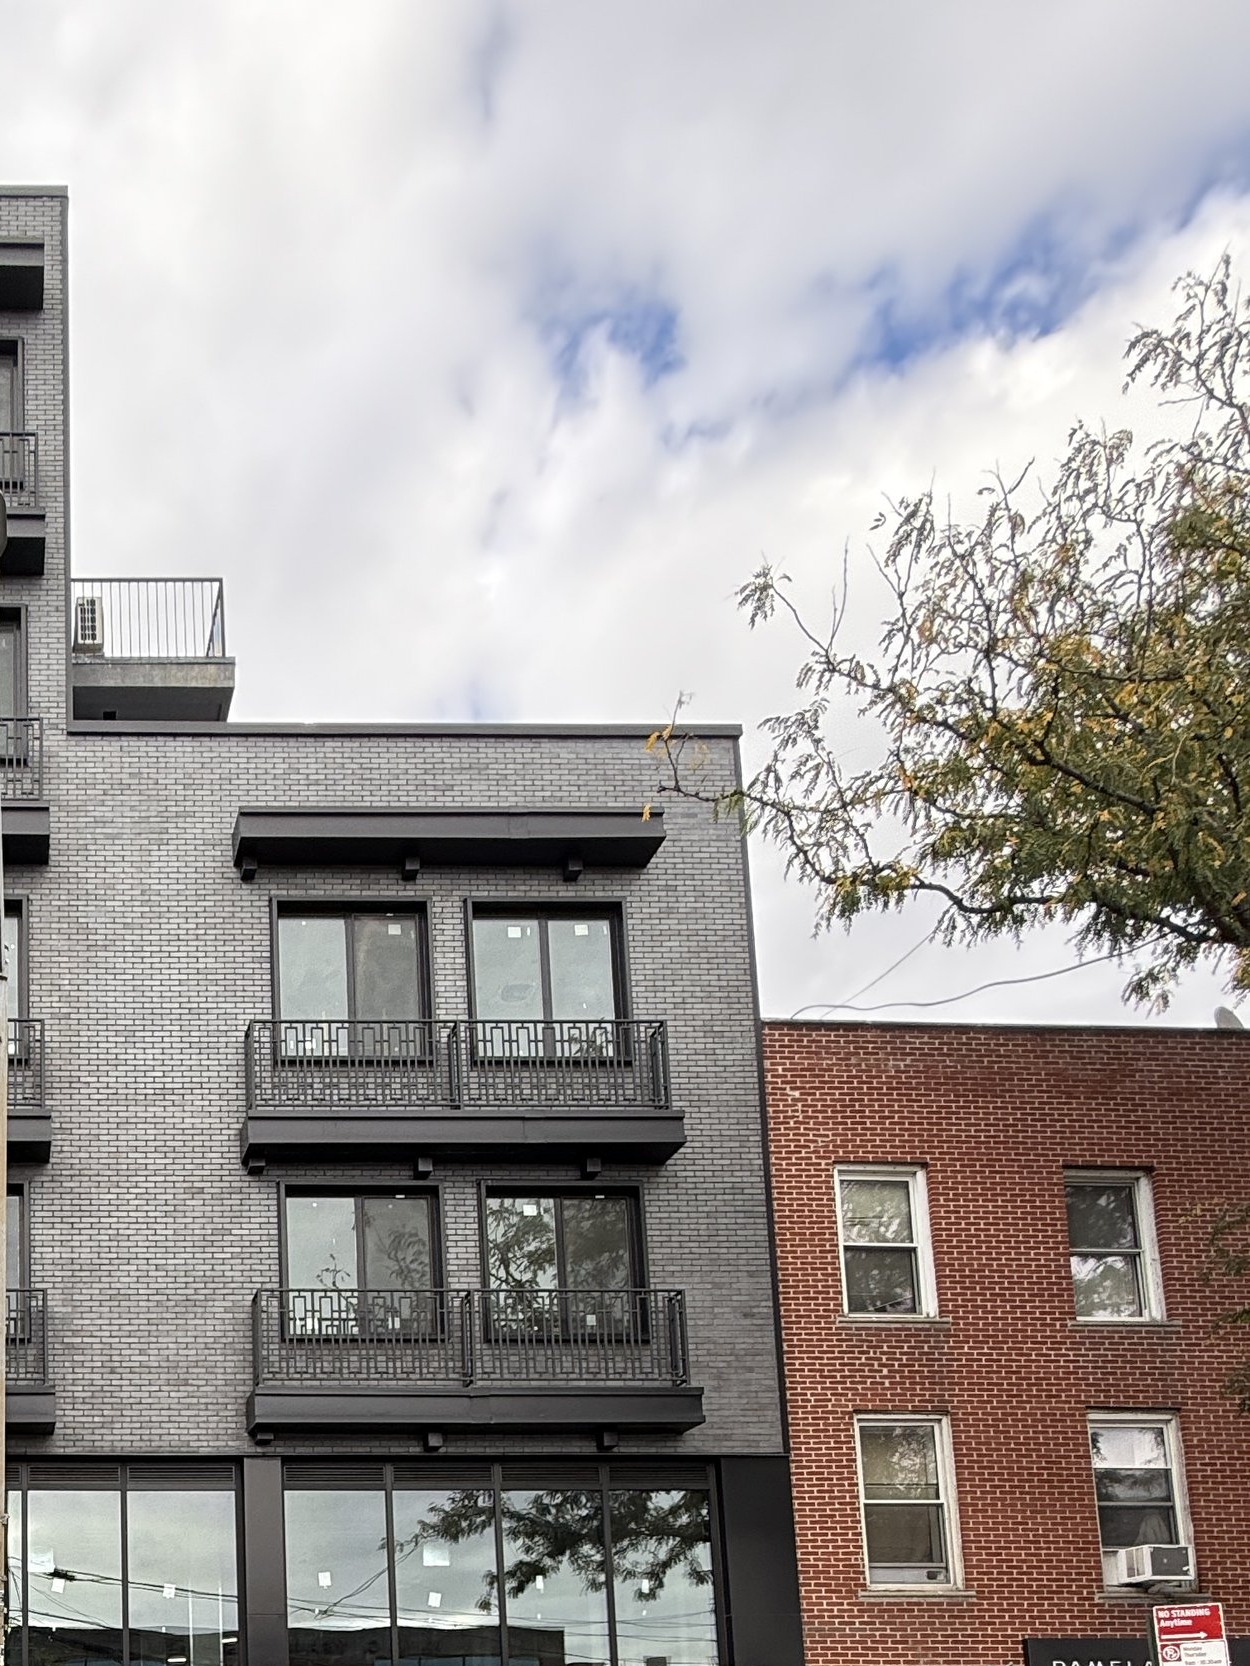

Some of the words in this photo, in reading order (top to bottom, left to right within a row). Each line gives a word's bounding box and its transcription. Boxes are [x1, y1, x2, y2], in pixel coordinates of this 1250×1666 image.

[1157, 1610, 1170, 1618] NO
[1171, 1608, 1211, 1618] STANDING
[1159, 1618, 1193, 1628] Anytime
